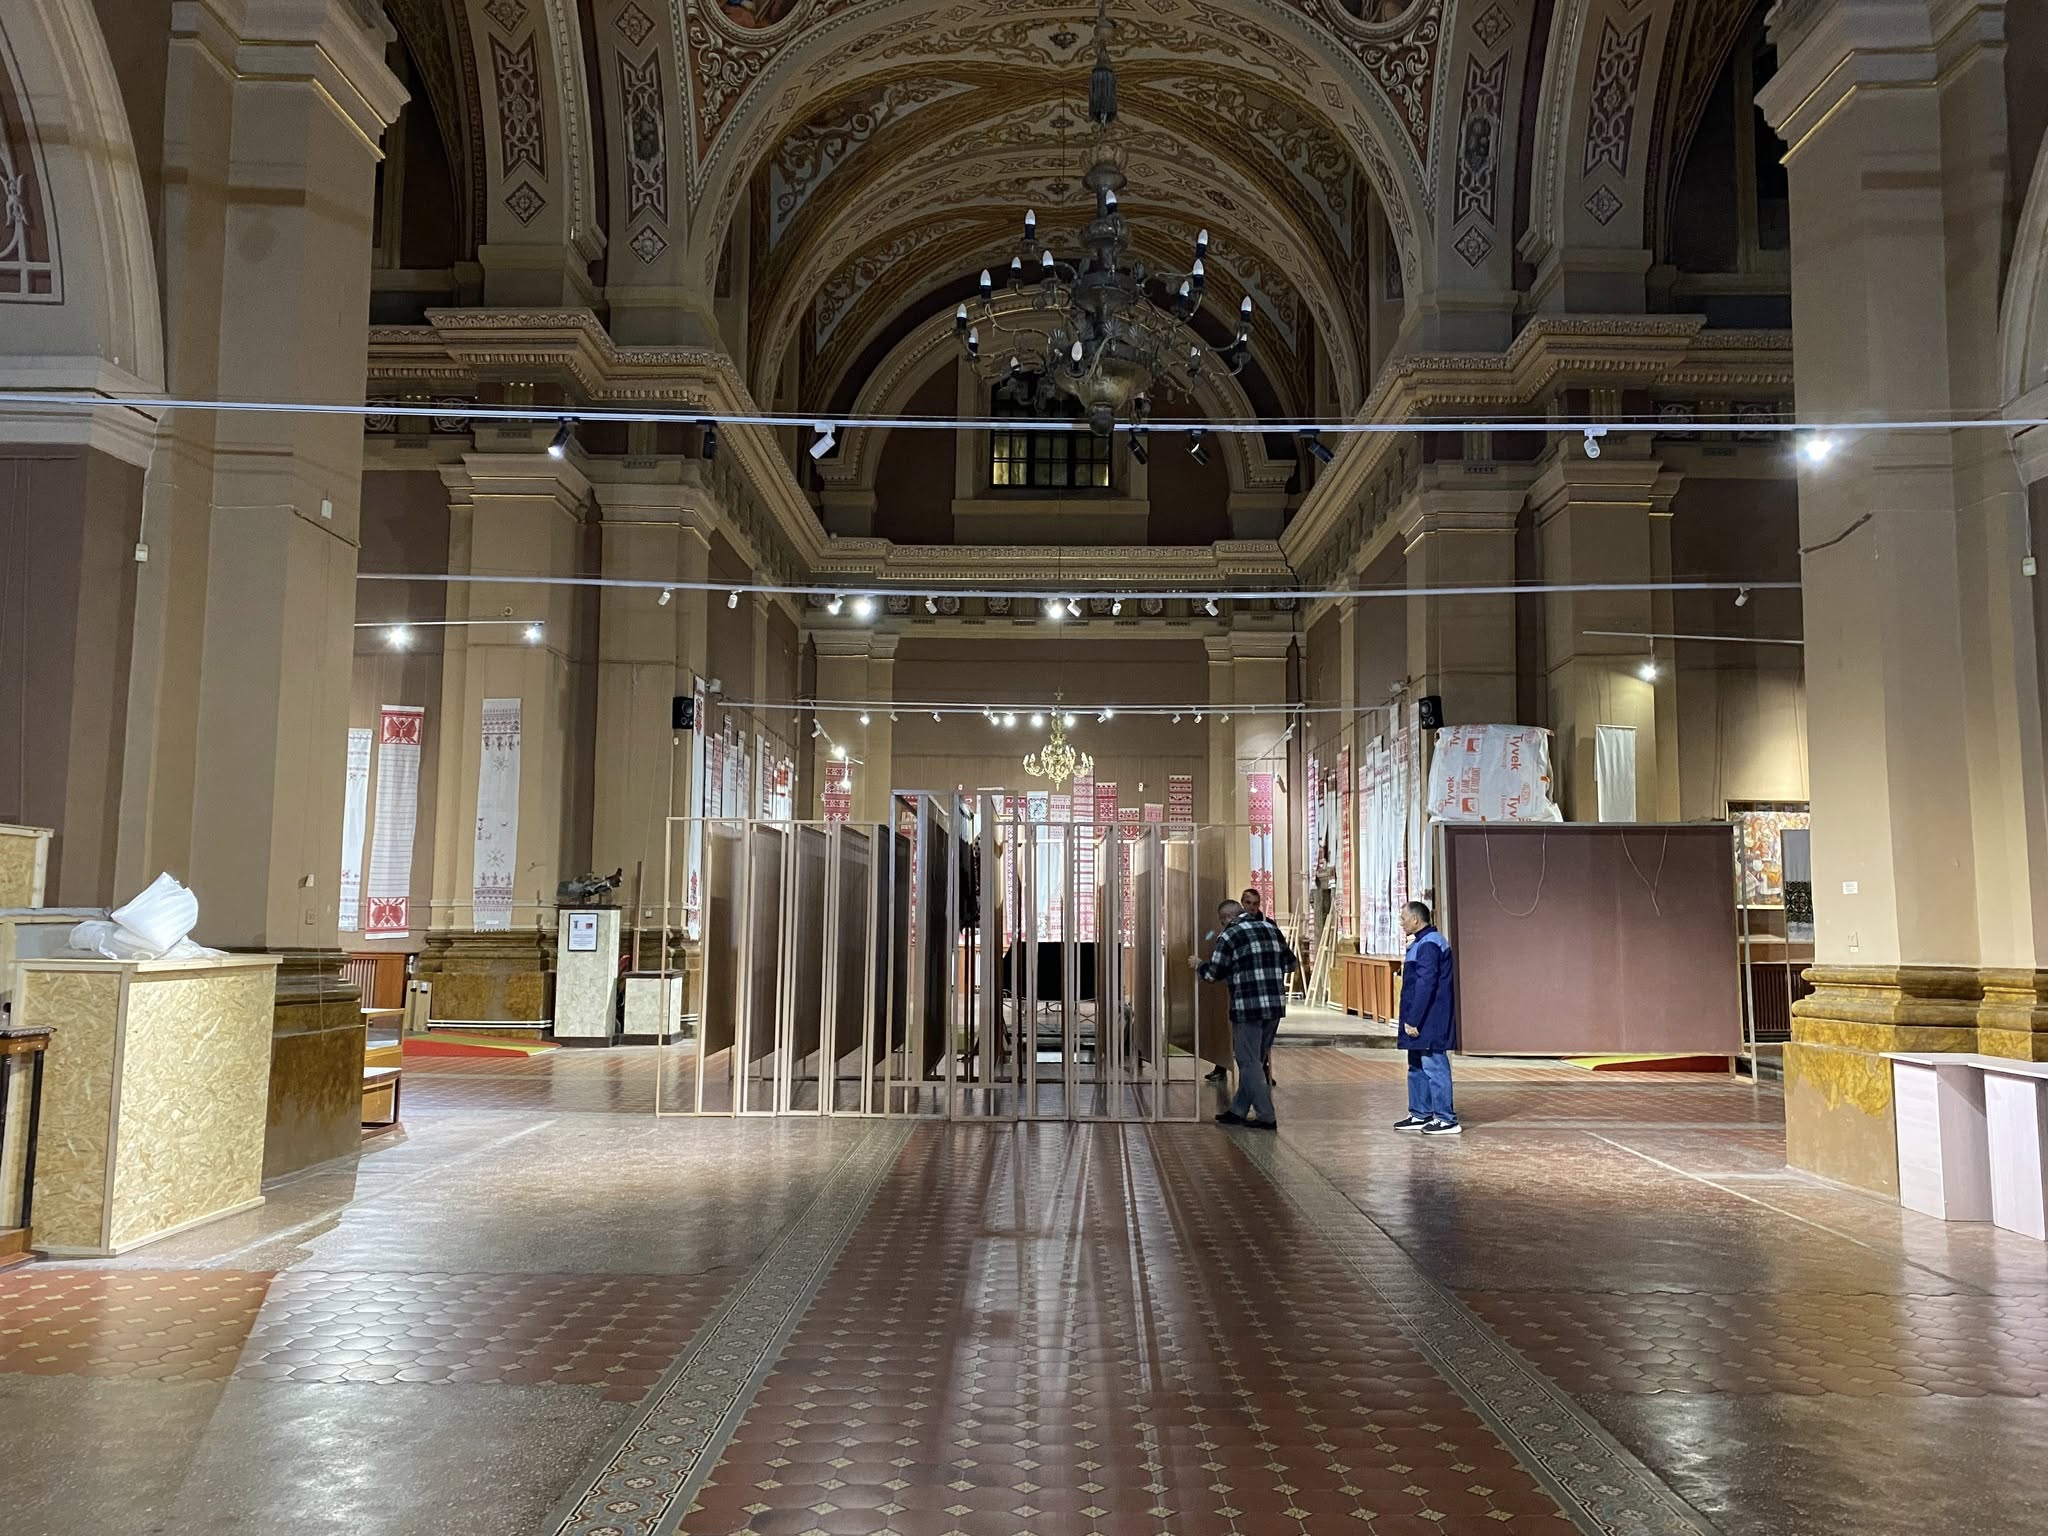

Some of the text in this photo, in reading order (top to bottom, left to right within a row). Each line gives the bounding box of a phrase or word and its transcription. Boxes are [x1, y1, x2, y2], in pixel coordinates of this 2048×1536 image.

[1449, 726, 1461, 748] Tyv
[1509, 733, 1524, 771] Tyvek
[1444, 775, 1456, 807] Tyvek
[1507, 795, 1521, 818] Tyv
